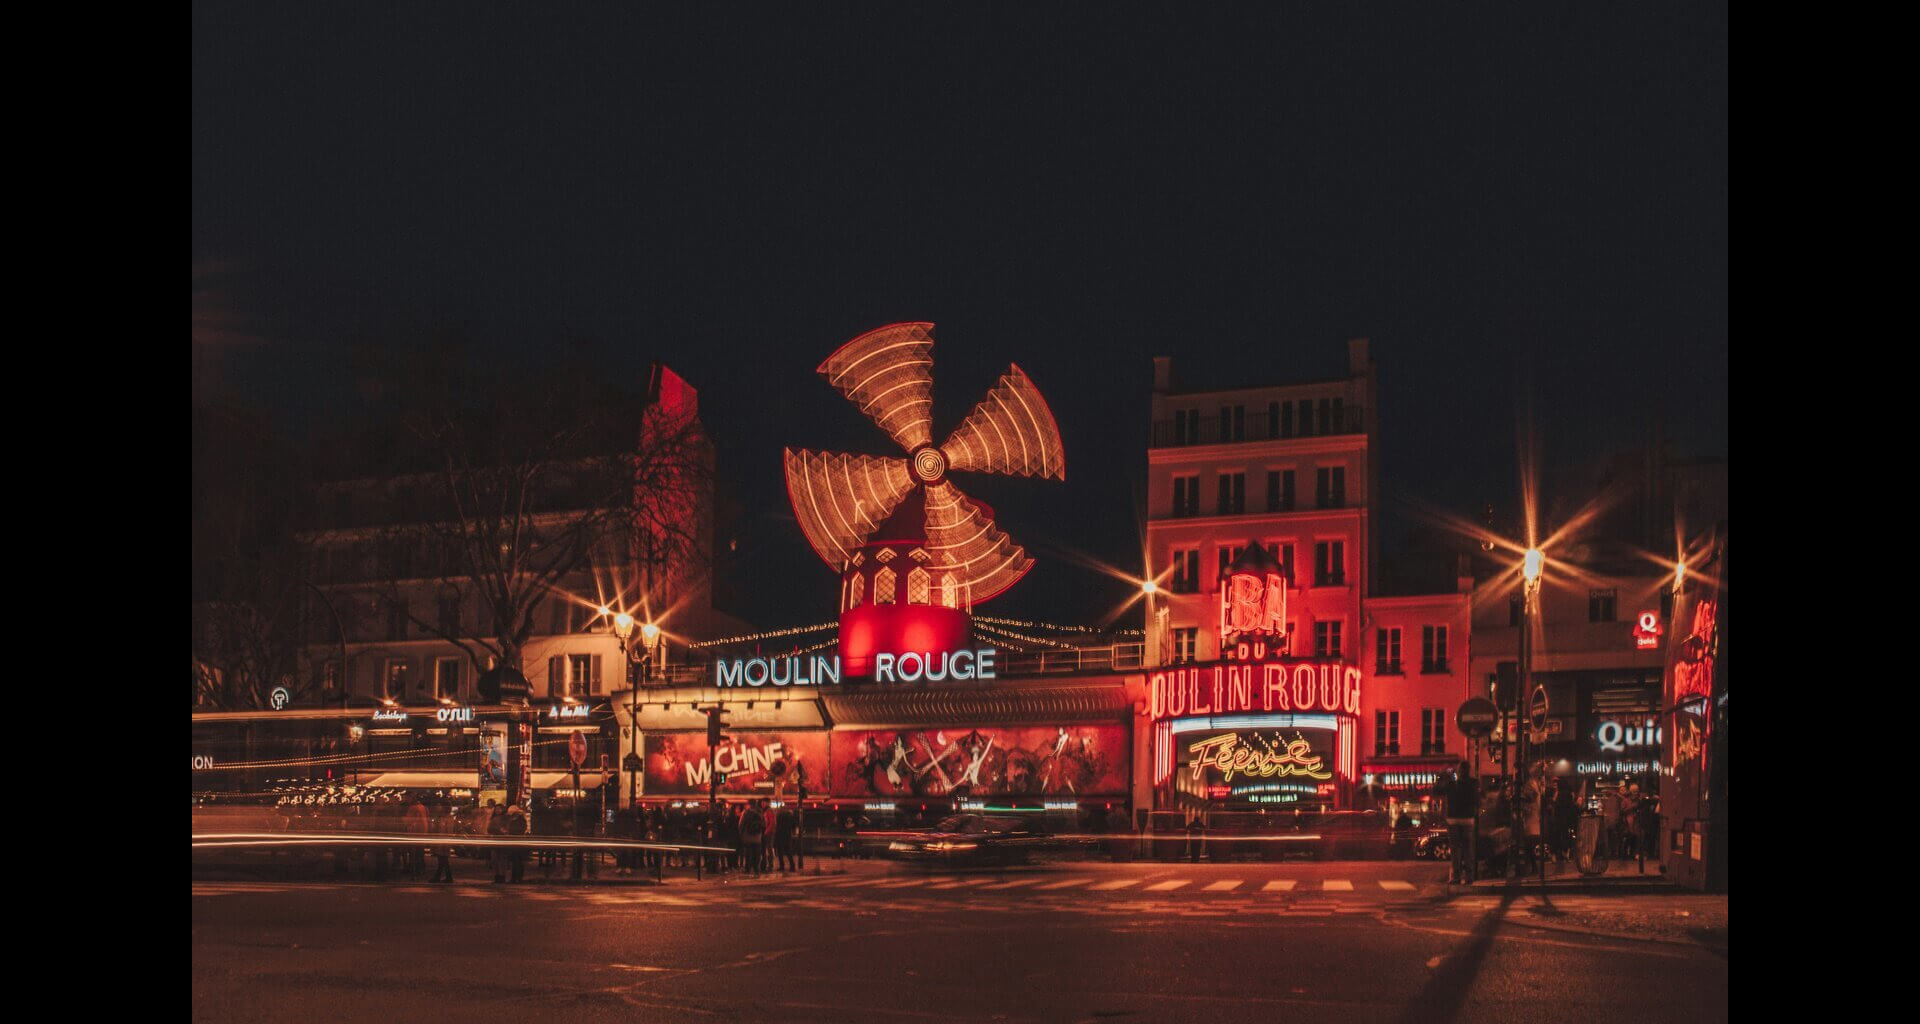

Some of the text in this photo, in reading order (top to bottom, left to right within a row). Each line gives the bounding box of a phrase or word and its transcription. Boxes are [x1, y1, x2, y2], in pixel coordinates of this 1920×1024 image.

[1640, 613, 1657, 632] Q
[1238, 642, 1265, 660] DU
[716, 649, 997, 687] MOULIN ROUGE
[1151, 663, 1362, 721] OULIN ROUG
[684, 742, 783, 787] MCHINE
[1577, 761, 1612, 775] Quality
[1616, 761, 1648, 773] Burger
